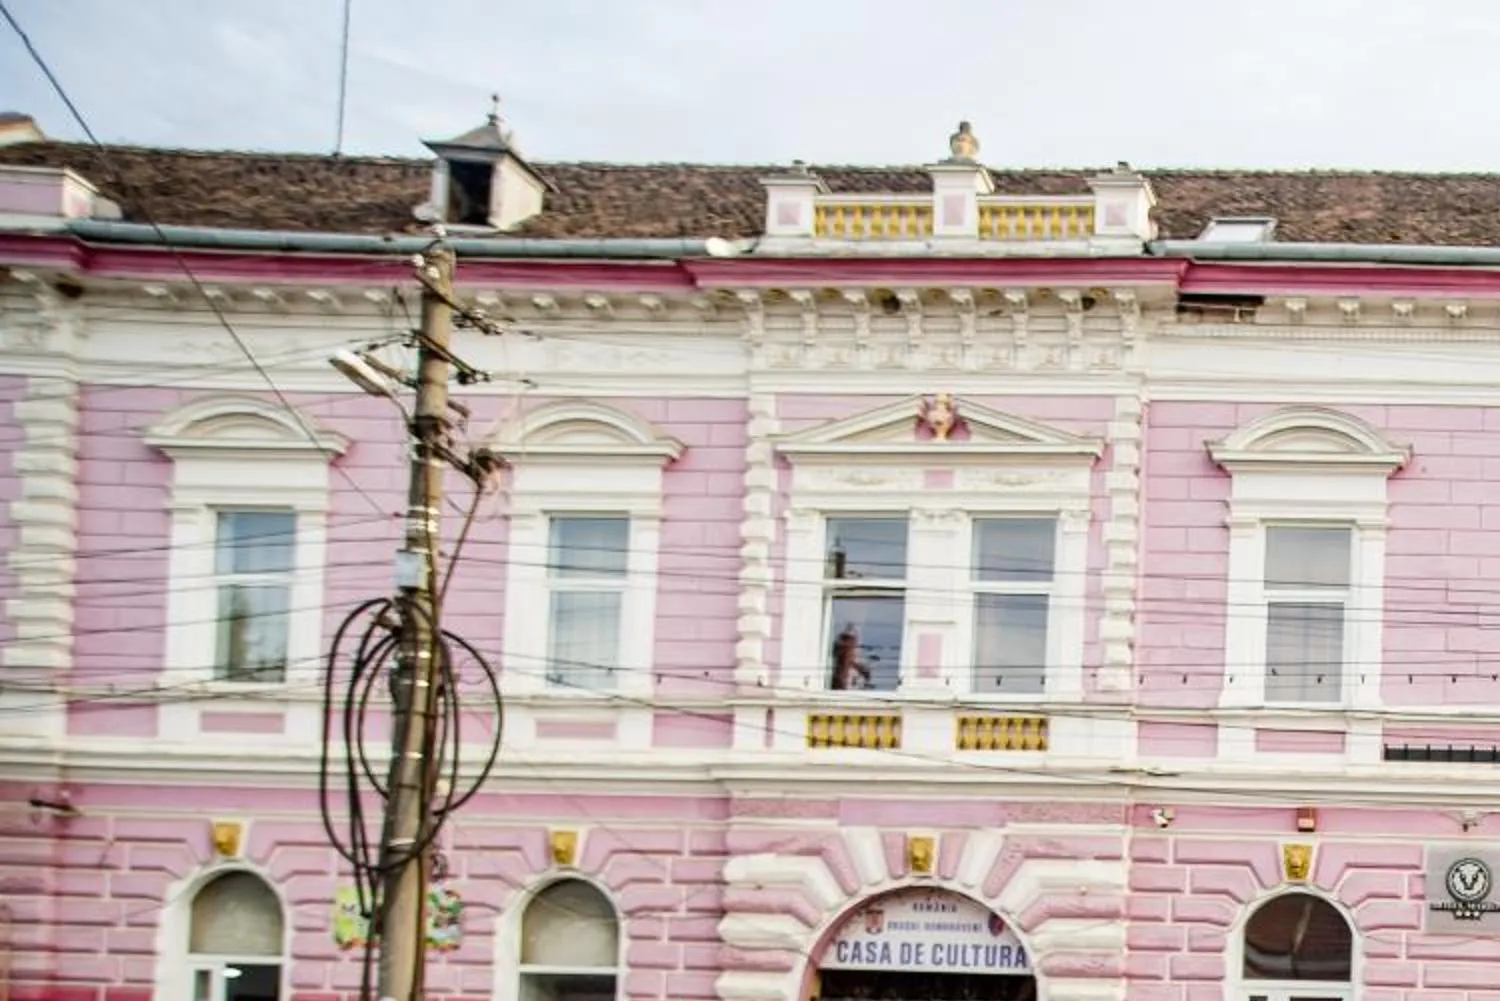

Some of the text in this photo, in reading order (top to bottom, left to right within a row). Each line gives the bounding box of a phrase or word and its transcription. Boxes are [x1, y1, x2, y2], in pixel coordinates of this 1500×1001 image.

[836, 940, 1027, 968] CASA DE CULTURA
